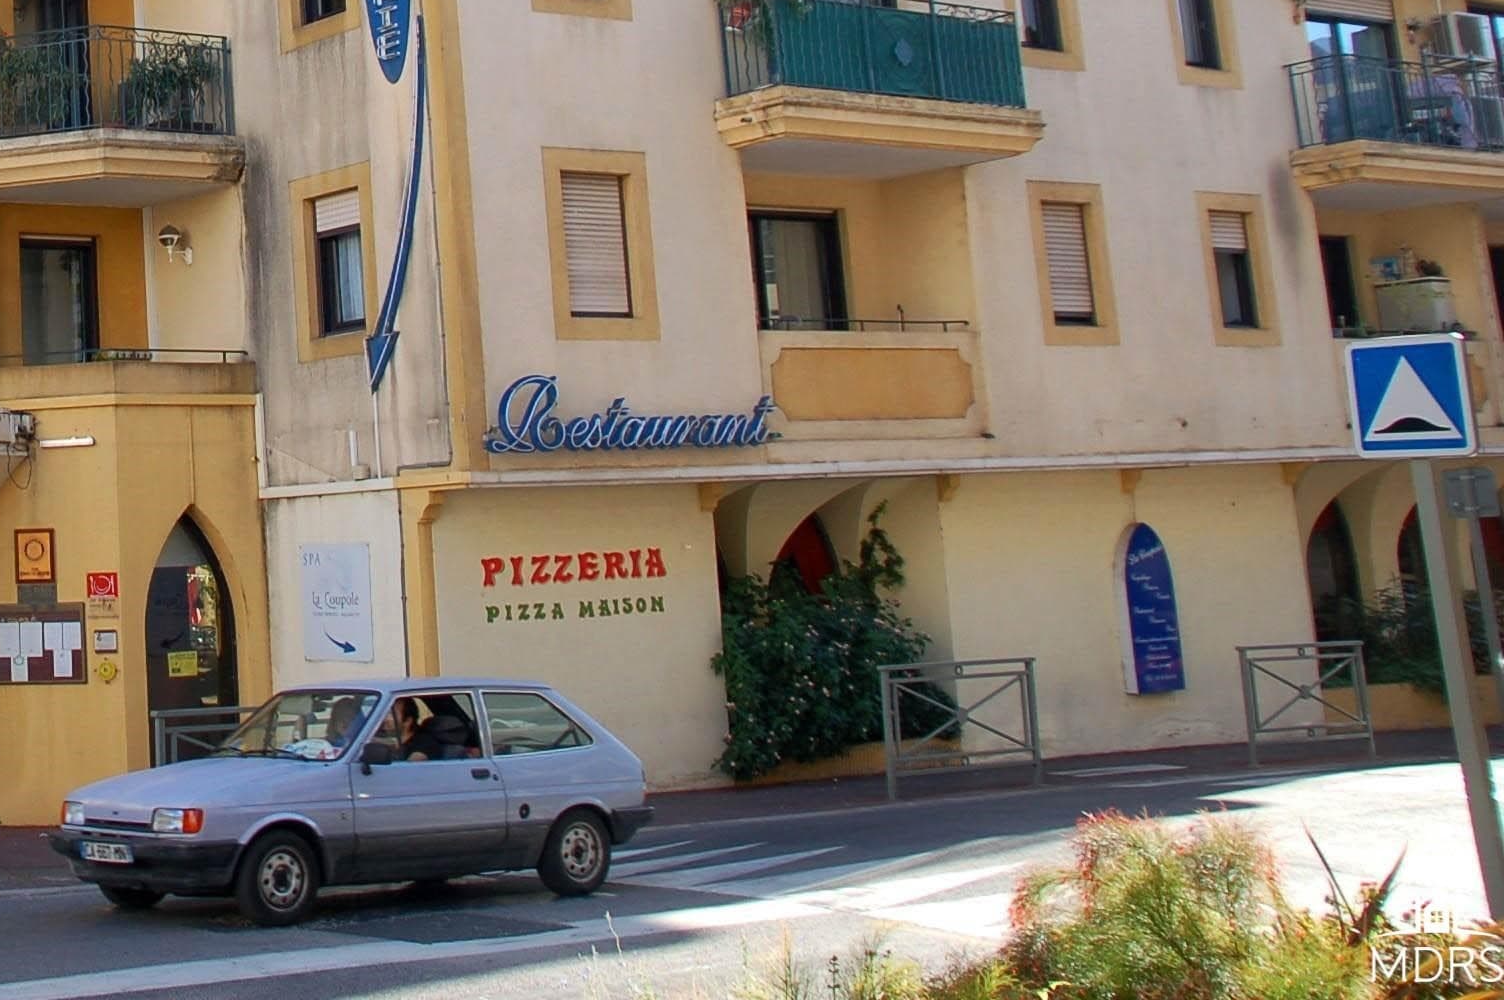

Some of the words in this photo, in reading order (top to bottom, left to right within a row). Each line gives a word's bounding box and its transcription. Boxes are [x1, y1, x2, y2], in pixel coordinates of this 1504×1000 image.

[484, 374, 778, 453] Restaurant
[302, 552, 321, 568] SPA
[480, 547, 668, 588] PIZZERIA
[324, 591, 360, 610] Coupole
[485, 602, 565, 625] PIZZA
[579, 595, 666, 620] MAISON
